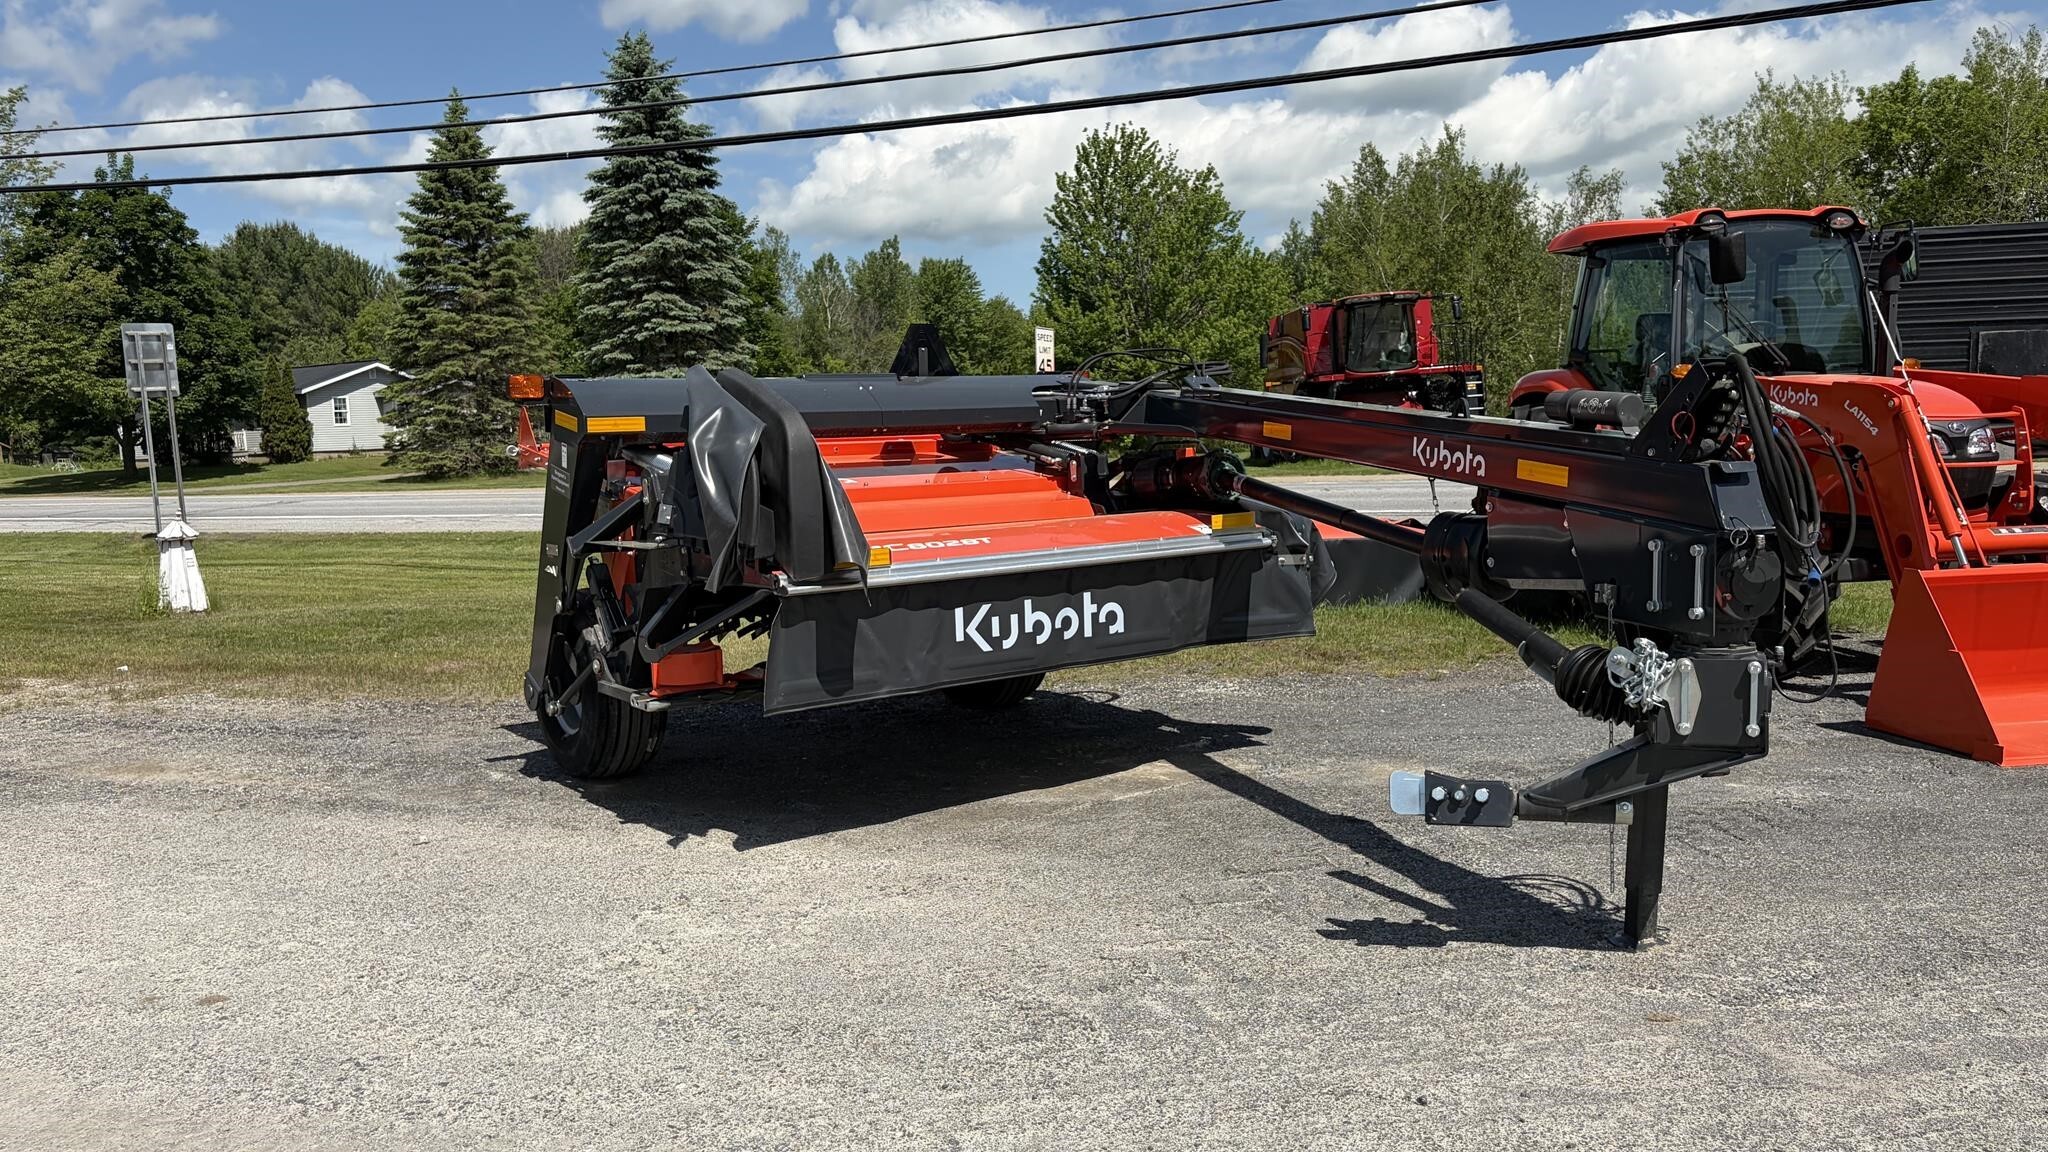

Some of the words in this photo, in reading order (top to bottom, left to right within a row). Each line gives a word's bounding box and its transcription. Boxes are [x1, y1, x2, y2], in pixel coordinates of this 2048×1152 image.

[1037, 333, 1052, 342] SPEED
[1038, 358, 1053, 372] 45
[1770, 384, 1819, 407] Kubota
[1843, 399, 1879, 436] LA1154
[1412, 436, 1486, 477] Kubota
[954, 591, 1125, 652] Kubota
